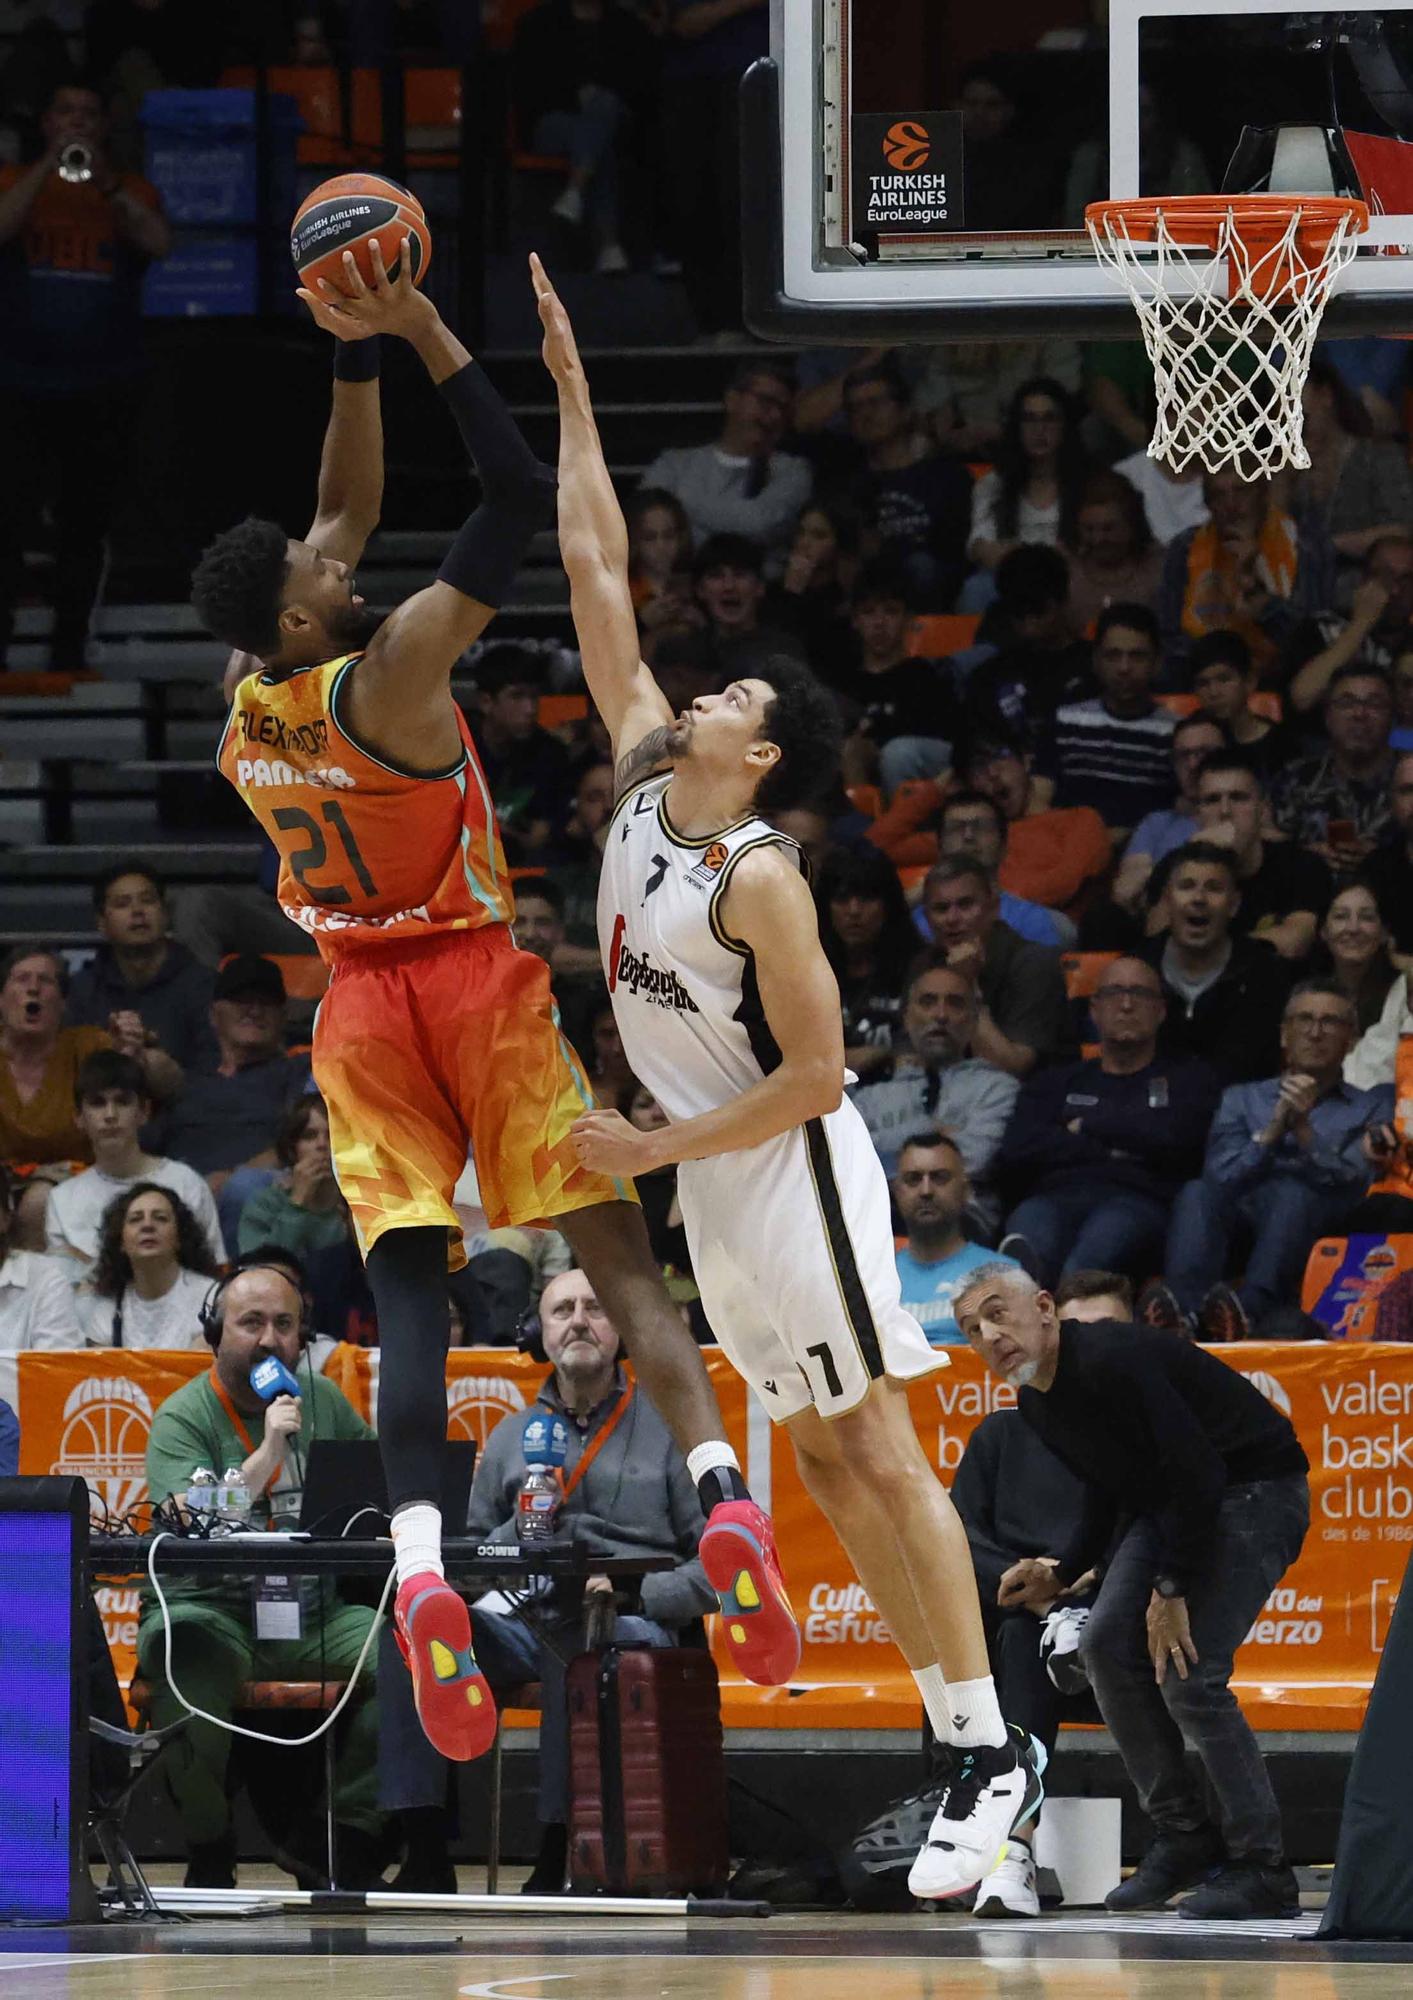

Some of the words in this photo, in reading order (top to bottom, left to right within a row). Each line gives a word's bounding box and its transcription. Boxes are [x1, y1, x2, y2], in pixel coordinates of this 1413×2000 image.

[869, 174, 945, 190] TURKISH
[329, 205, 371, 222] AIRLINES
[868, 190, 947, 207] AIRLINES
[867, 208, 948, 224] EuroLeague
[300, 219, 352, 251] EuroLeague
[271, 799, 379, 905] 21
[806, 1341, 844, 1398] 7
[936, 1369, 1019, 1416] vale
[1322, 1423, 1413, 1470] bask
[1321, 1474, 1413, 1519] club
[1297, 1595, 1323, 1612] del
[805, 1612, 893, 1644] Esfue
